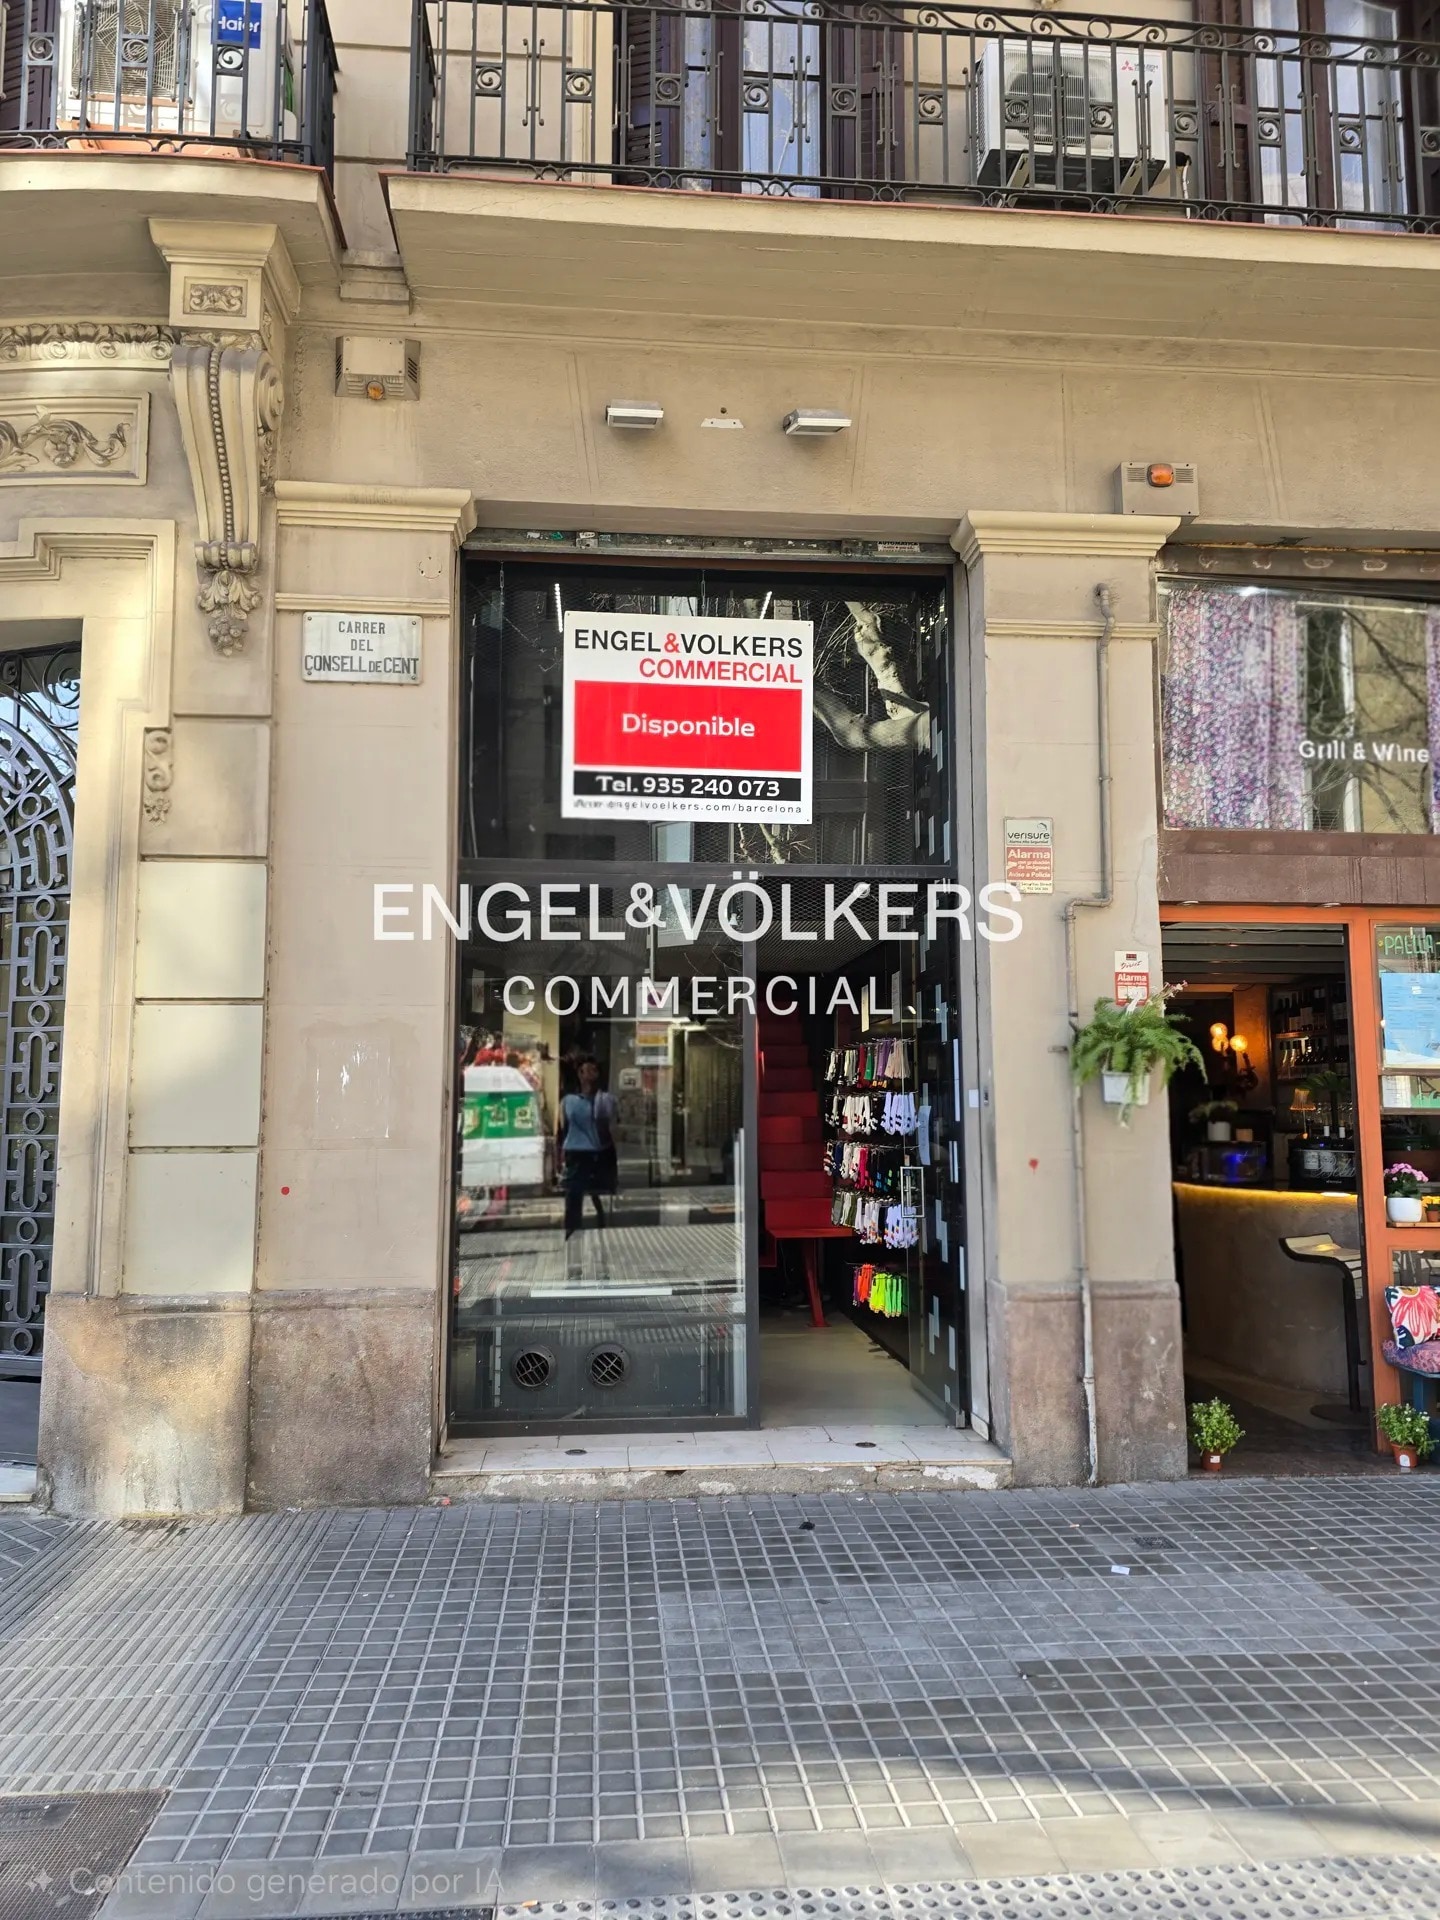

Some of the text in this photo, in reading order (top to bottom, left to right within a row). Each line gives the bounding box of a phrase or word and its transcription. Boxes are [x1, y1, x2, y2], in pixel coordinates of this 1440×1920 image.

[338, 621, 386, 634] CARRER
[350, 639, 374, 652] DEL
[304, 655, 420, 675] CONSELL DE CENT
[639, 658, 803, 684] COMMERCIAL
[622, 713, 755, 737] Disponible
[1298, 740, 1430, 763] Grill & Wine
[595, 775, 780, 797] Tel. 935 240 073
[1007, 832, 1050, 840] verisure
[1007, 849, 1051, 859] Alarma
[1384, 934, 1434, 956] PAELLA
[1117, 973, 1147, 982] Alarma
